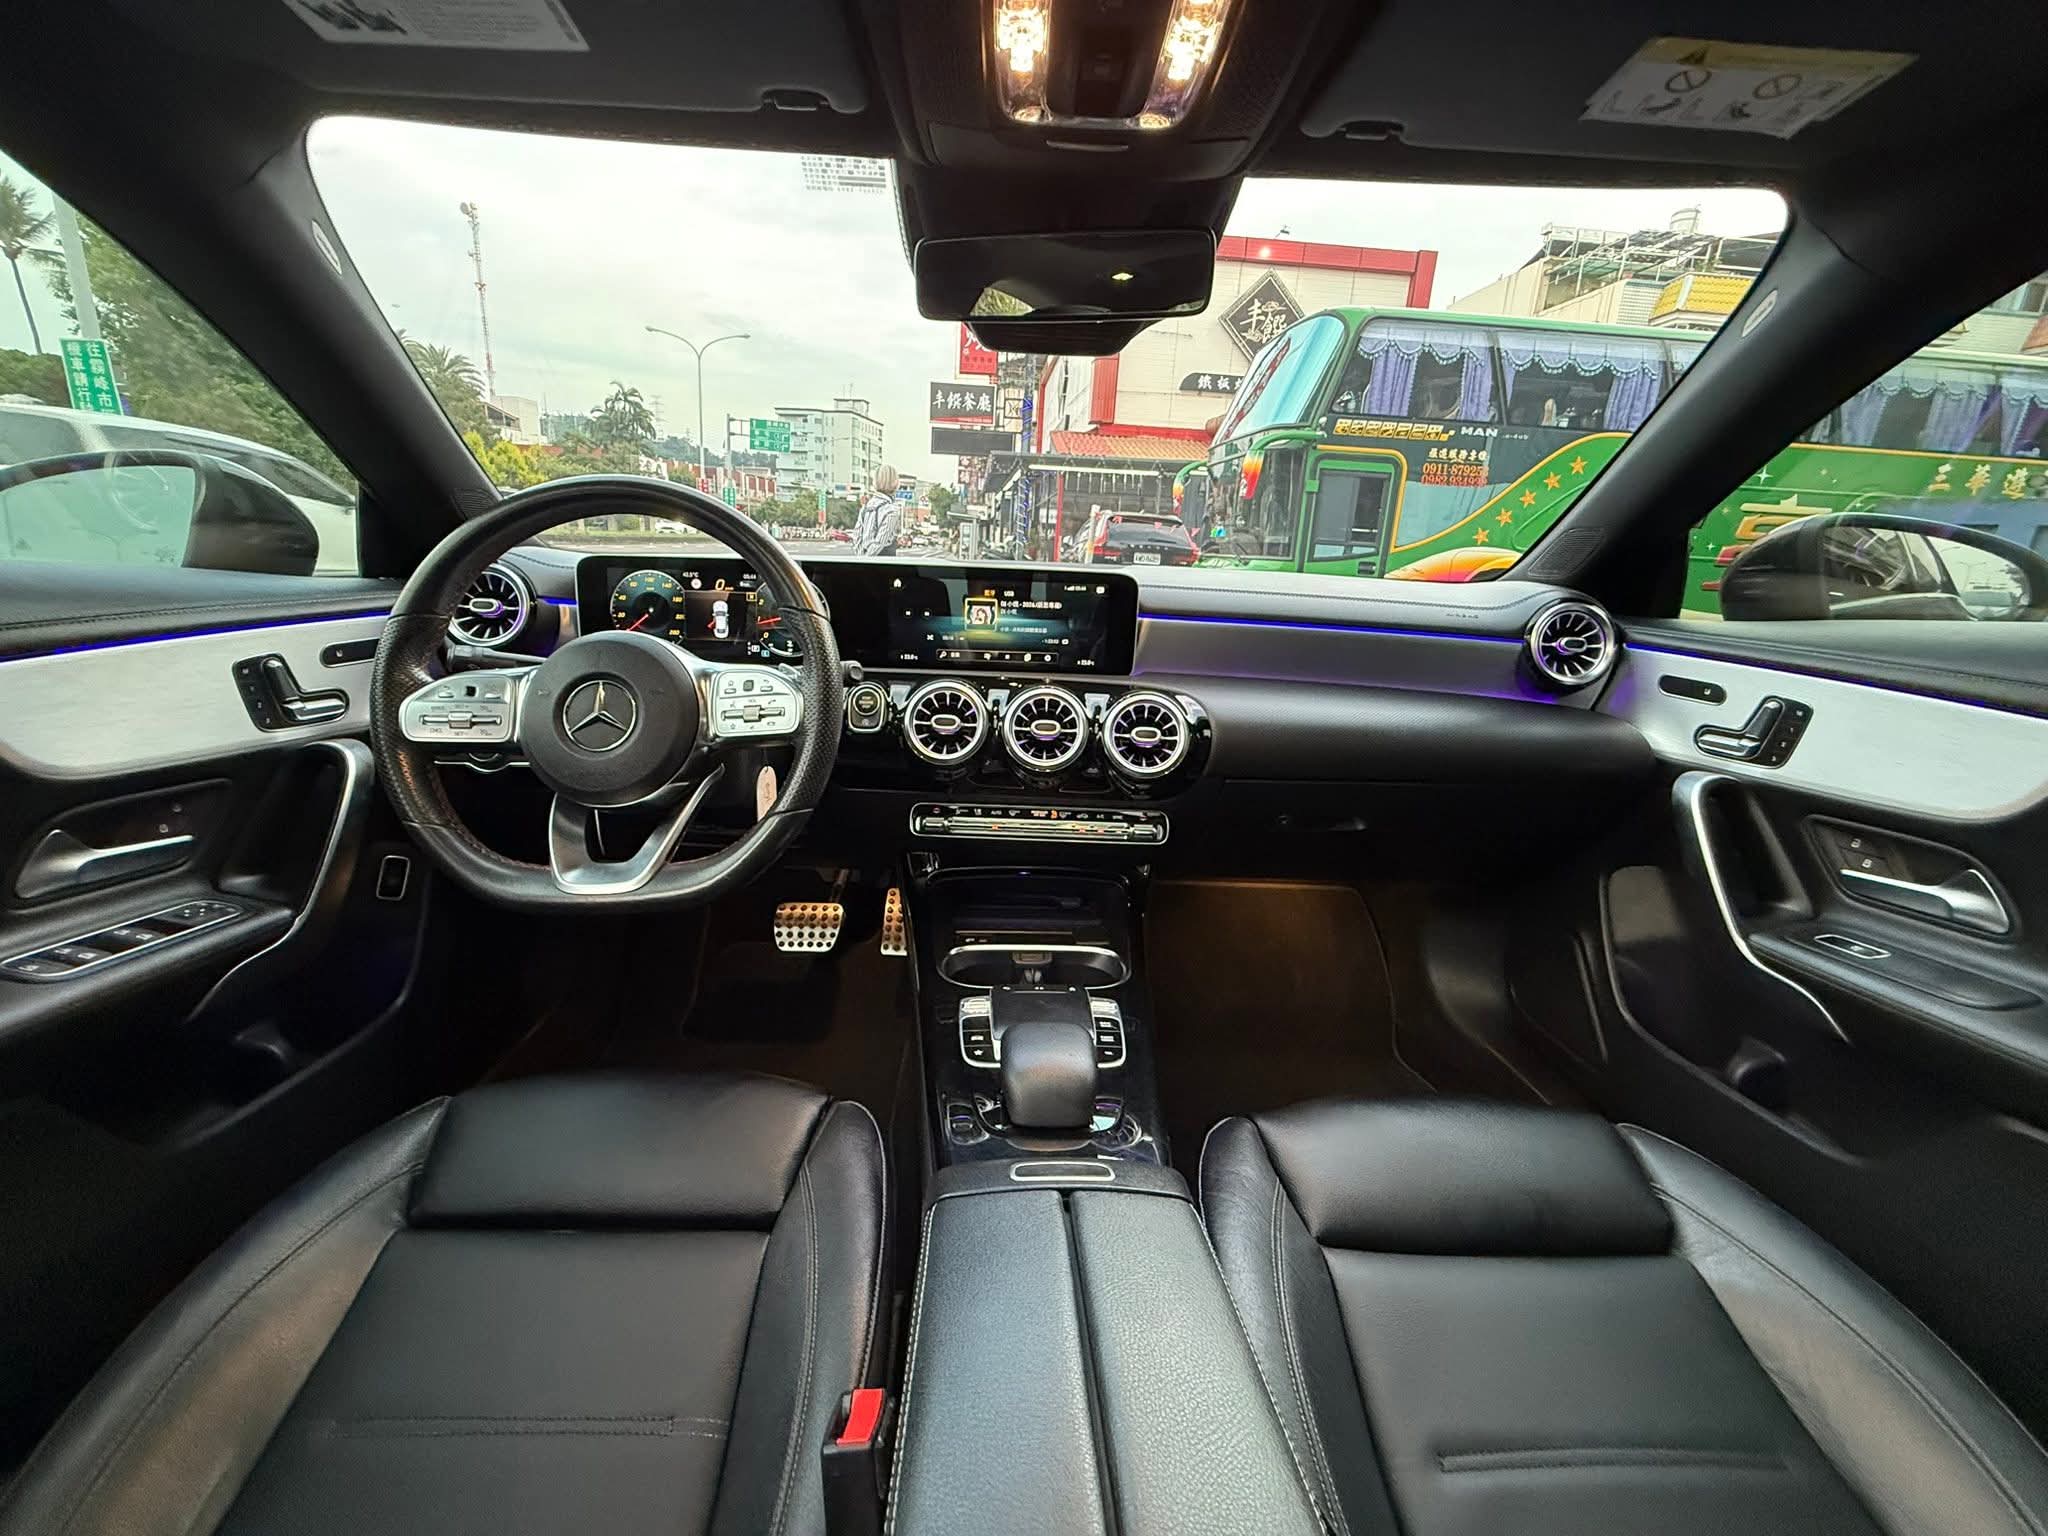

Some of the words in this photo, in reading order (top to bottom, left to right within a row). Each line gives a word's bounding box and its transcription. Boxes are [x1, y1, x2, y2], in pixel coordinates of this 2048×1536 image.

[85, 342, 115, 412] 往霧峰市
[1460, 426, 1498, 438] MAN
[715, 578, 725, 591] 0
